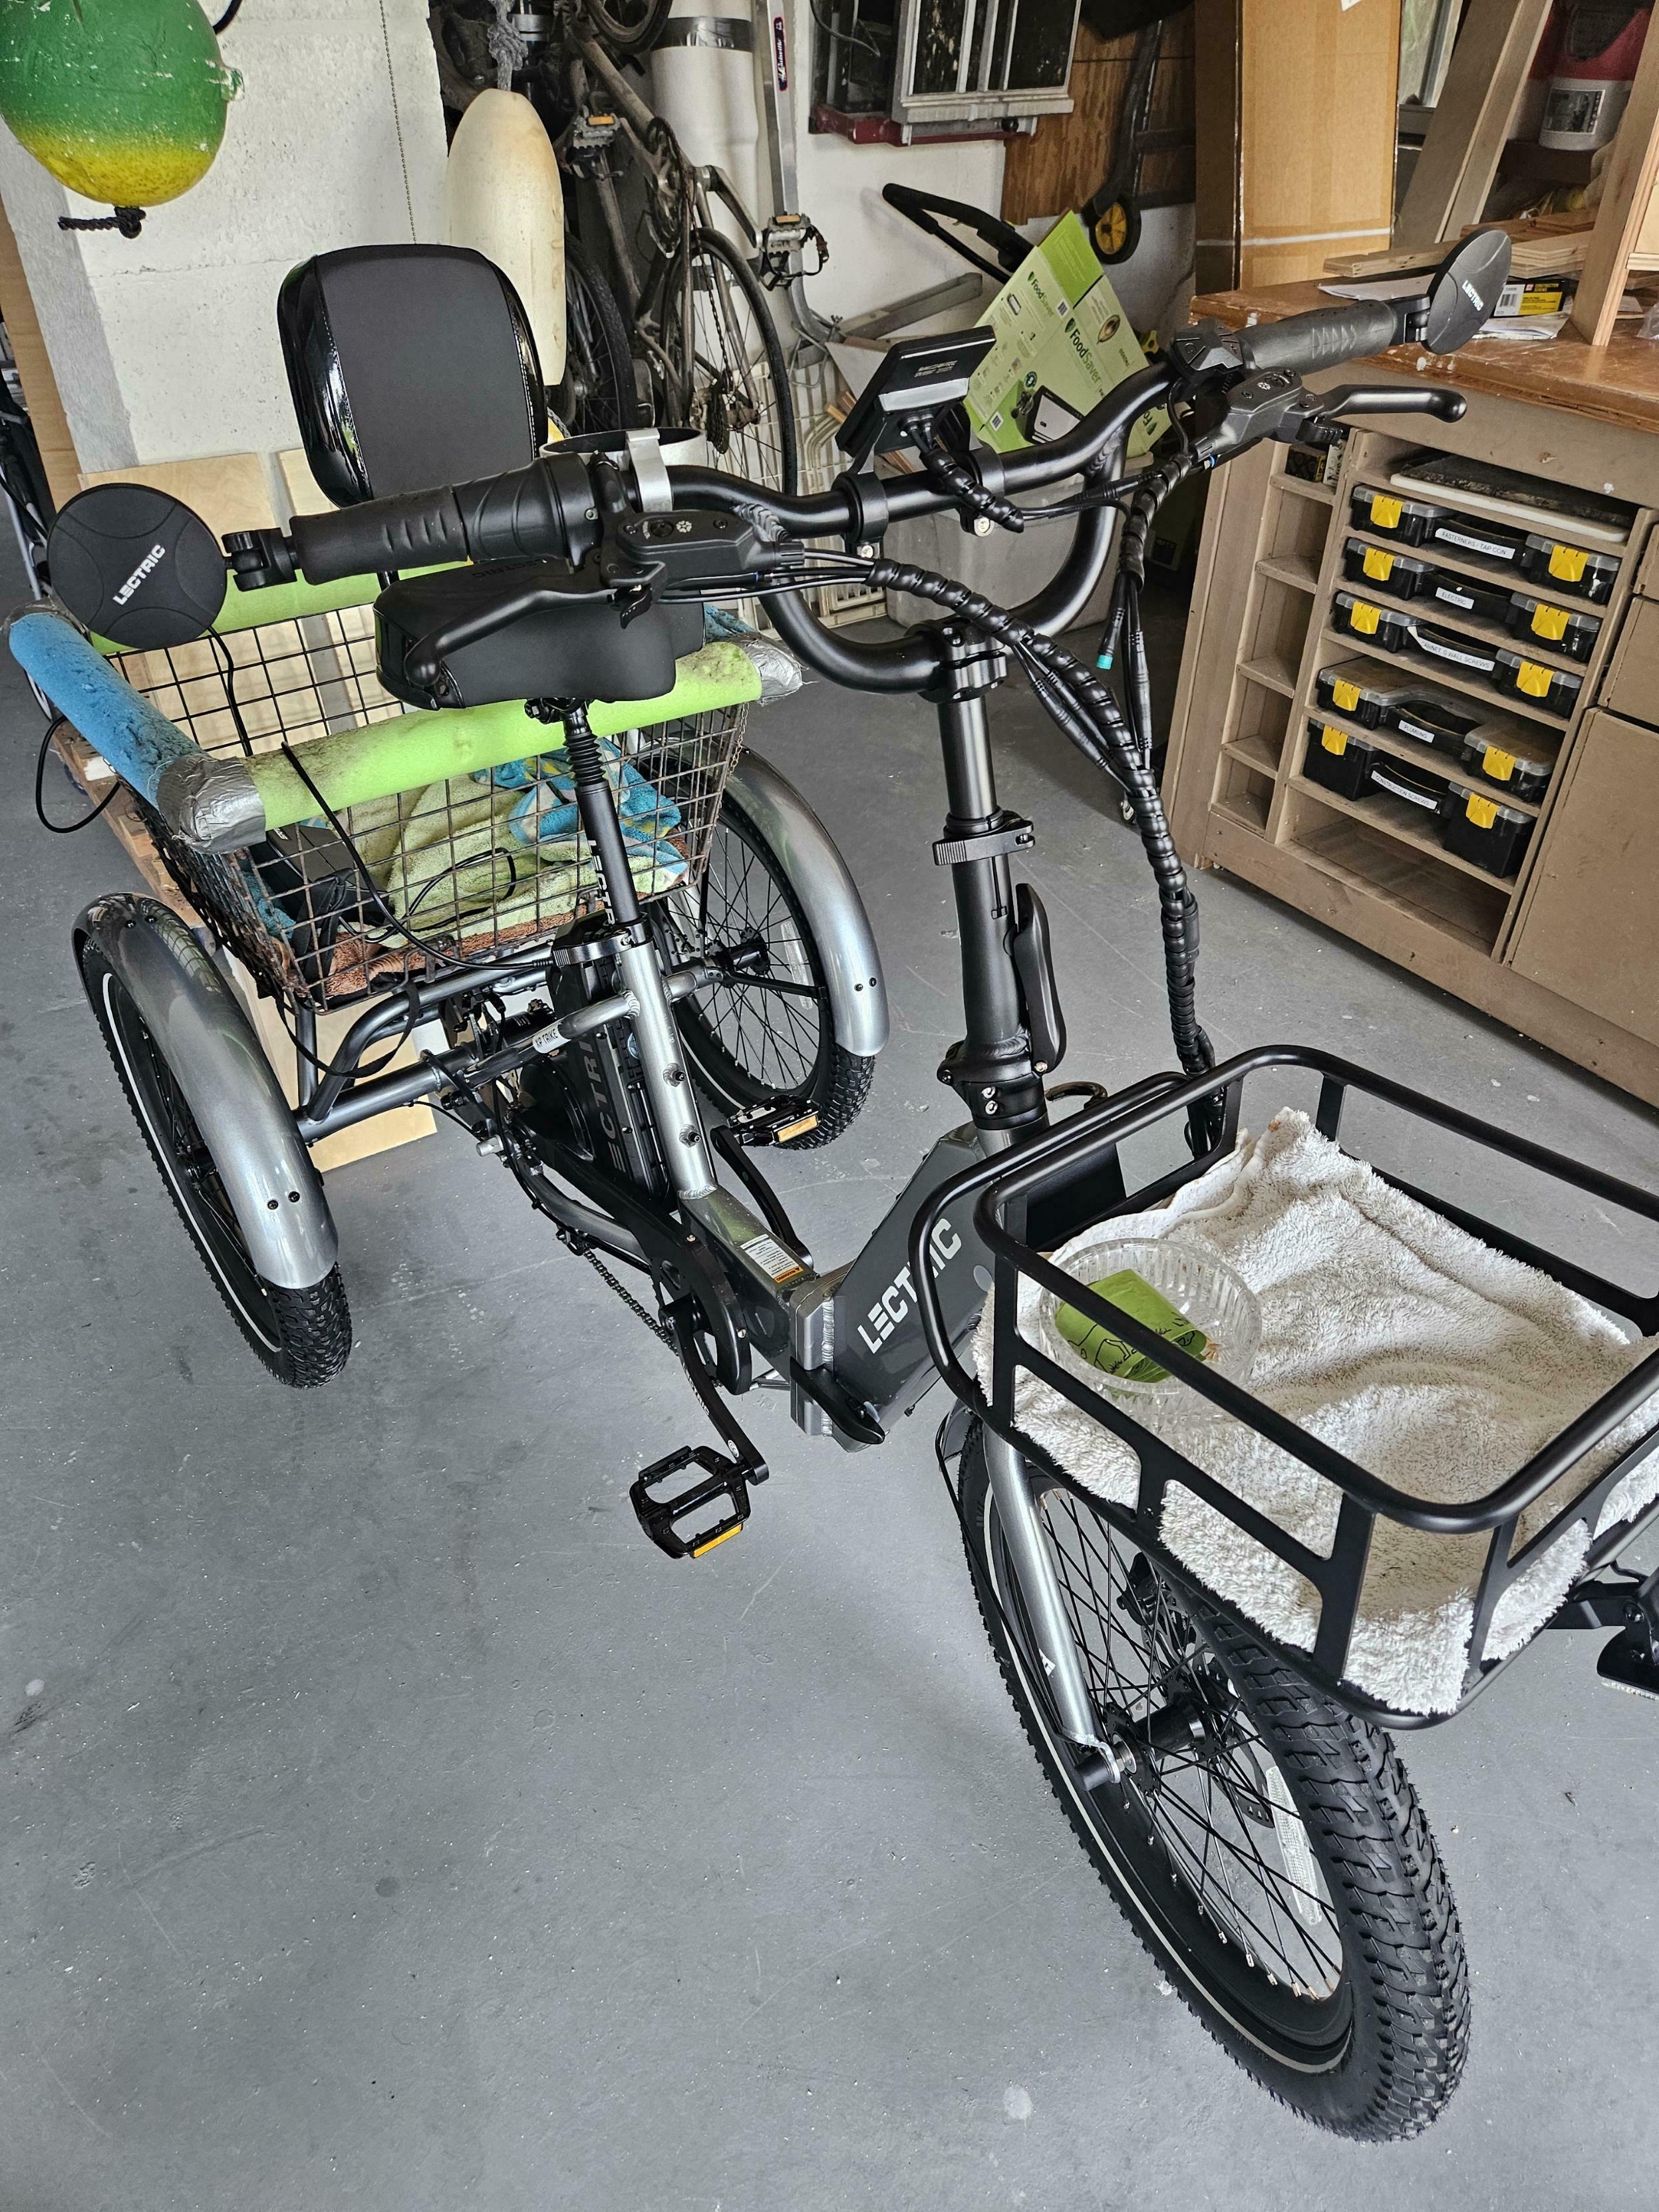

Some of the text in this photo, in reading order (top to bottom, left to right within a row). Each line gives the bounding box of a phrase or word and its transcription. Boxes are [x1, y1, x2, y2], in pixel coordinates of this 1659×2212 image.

[1031, 278, 1054, 317] FoodSaver
[1461, 279, 1484, 311] LECTRIC
[1070, 328, 1101, 384] FoodSaver
[112, 544, 166, 605] LECTRIC
[1464, 657, 1489, 669] SCREWS
[542, 1028, 558, 1044] TRIKE
[776, 1270, 796, 1281] WARNING
[857, 1218, 962, 1354] LECTIC
